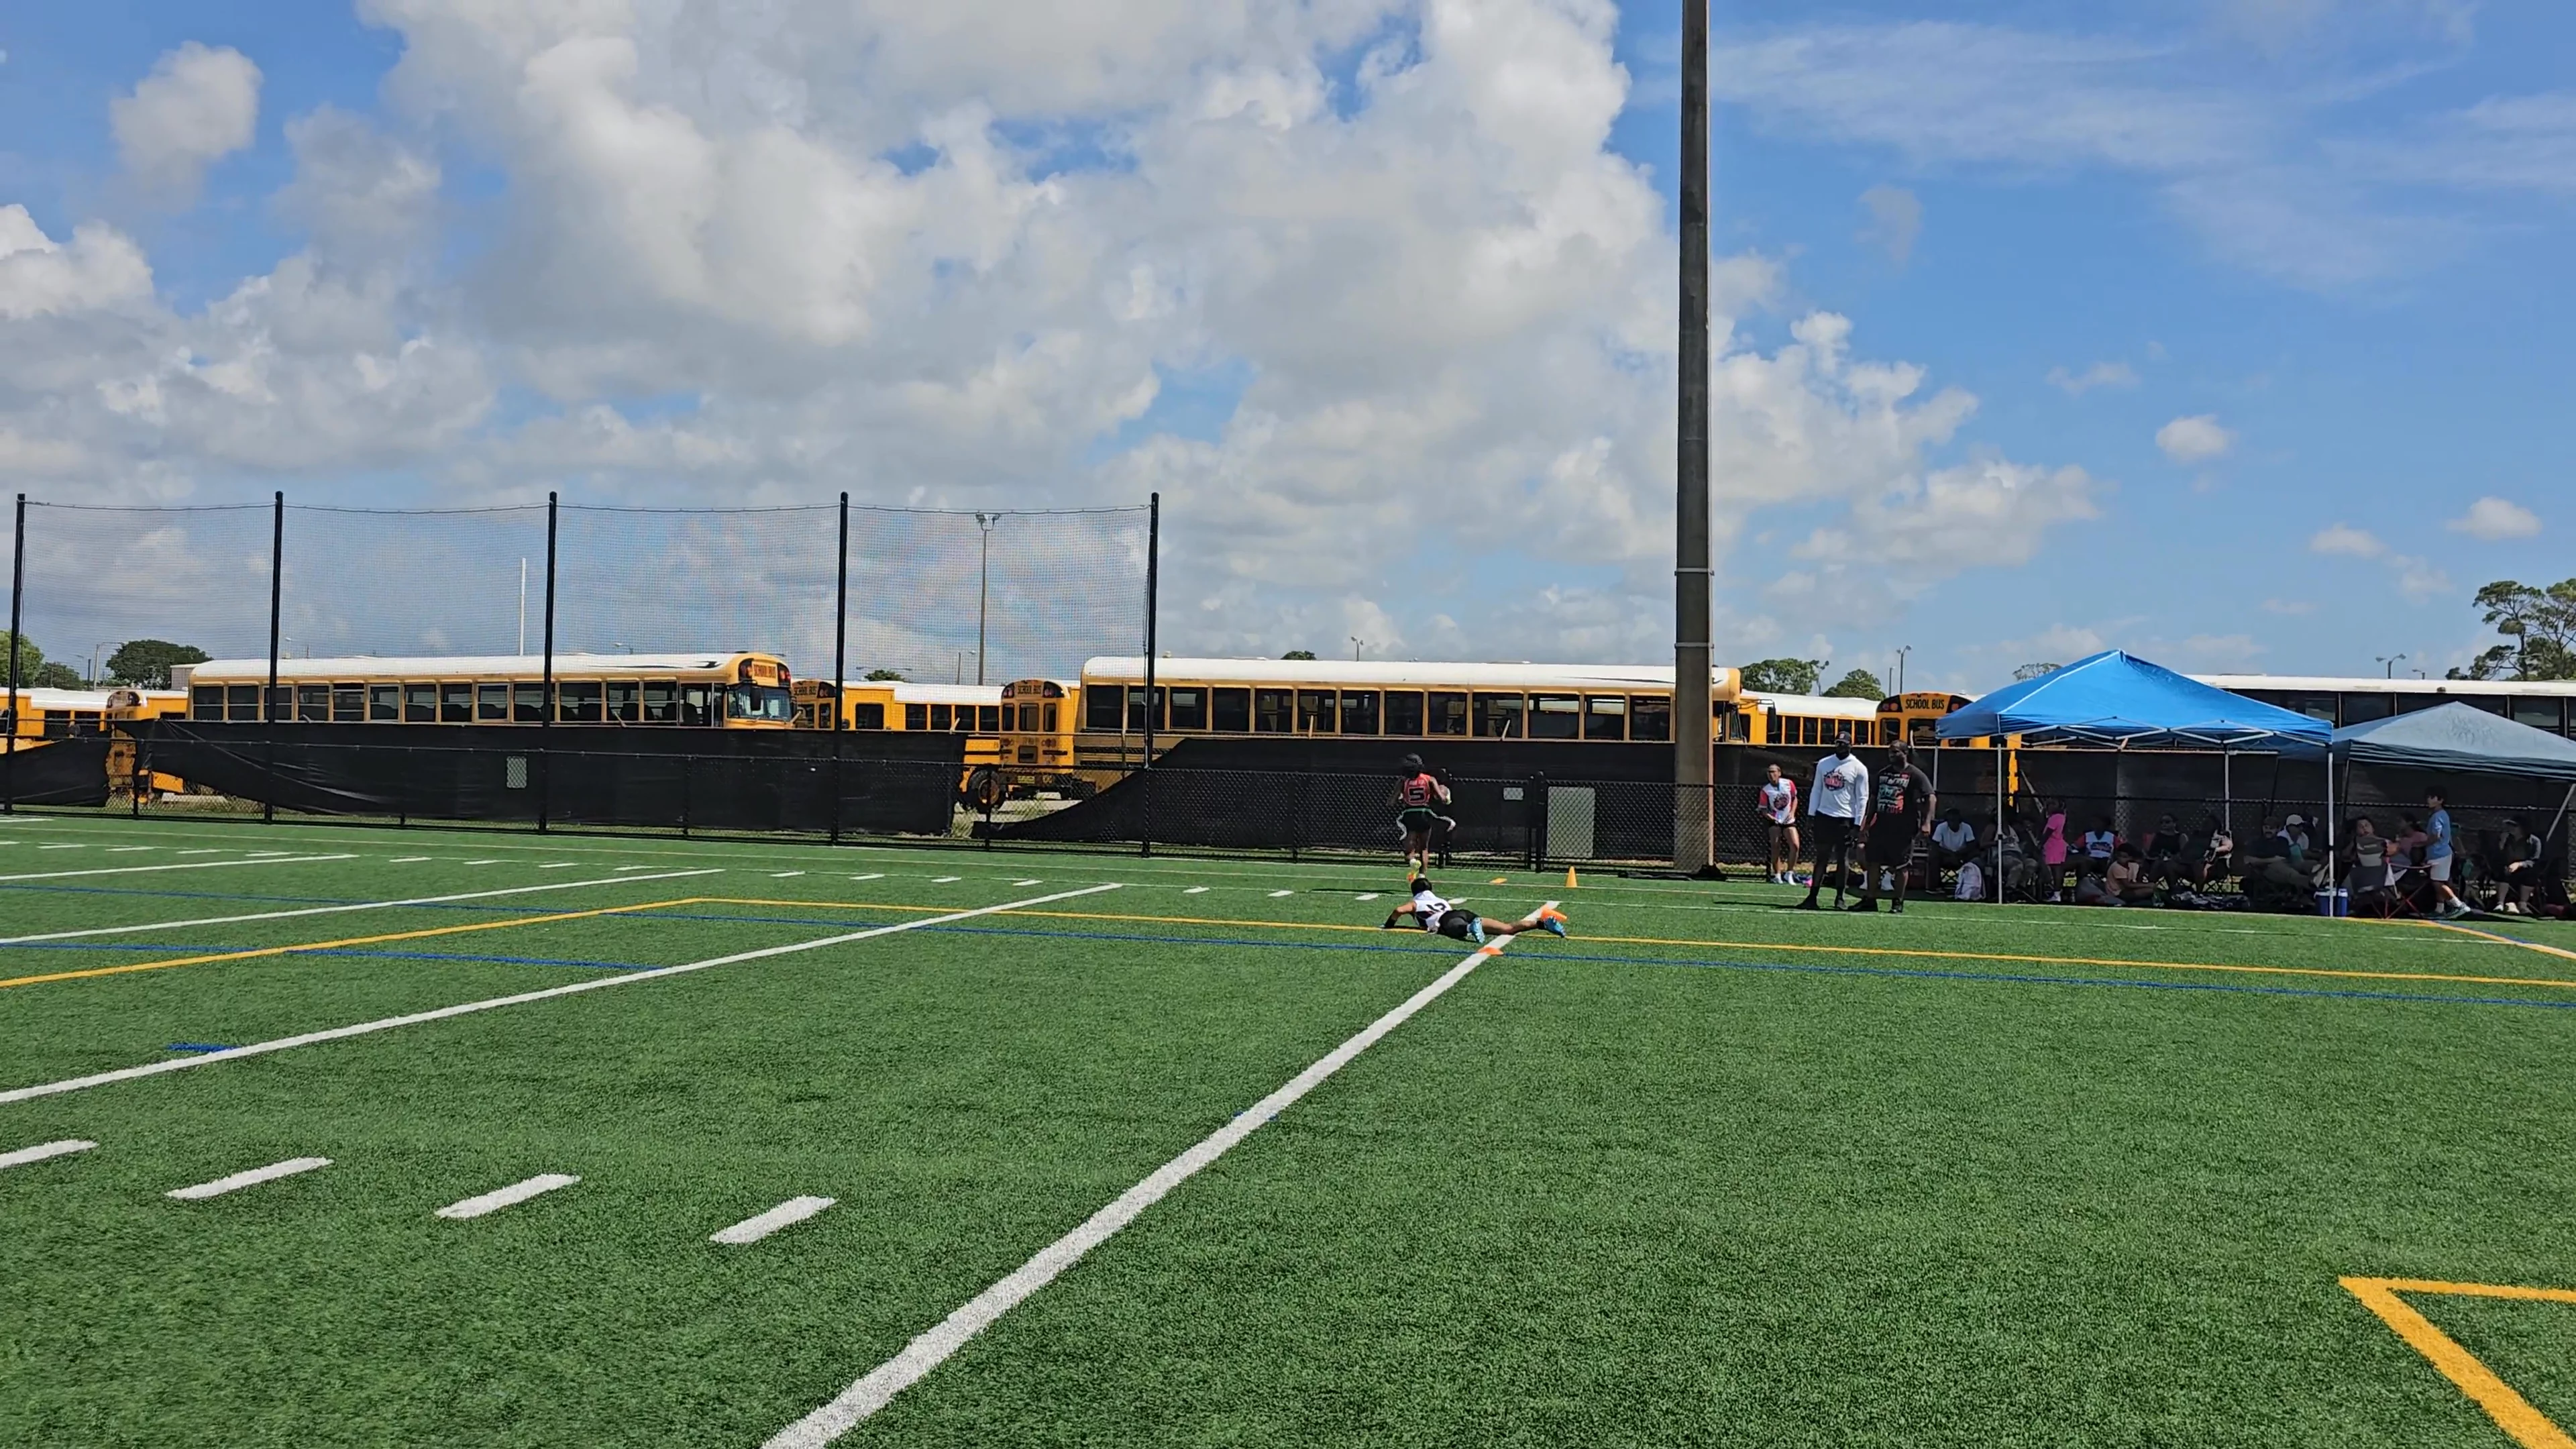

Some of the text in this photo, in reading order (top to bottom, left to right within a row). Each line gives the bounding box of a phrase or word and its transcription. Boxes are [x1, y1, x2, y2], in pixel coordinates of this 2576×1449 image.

[1018, 685, 1042, 694] SCHOOL BUS
[1905, 698, 1945, 710] SCHOOL BUS
[1408, 786, 1426, 802] 5
